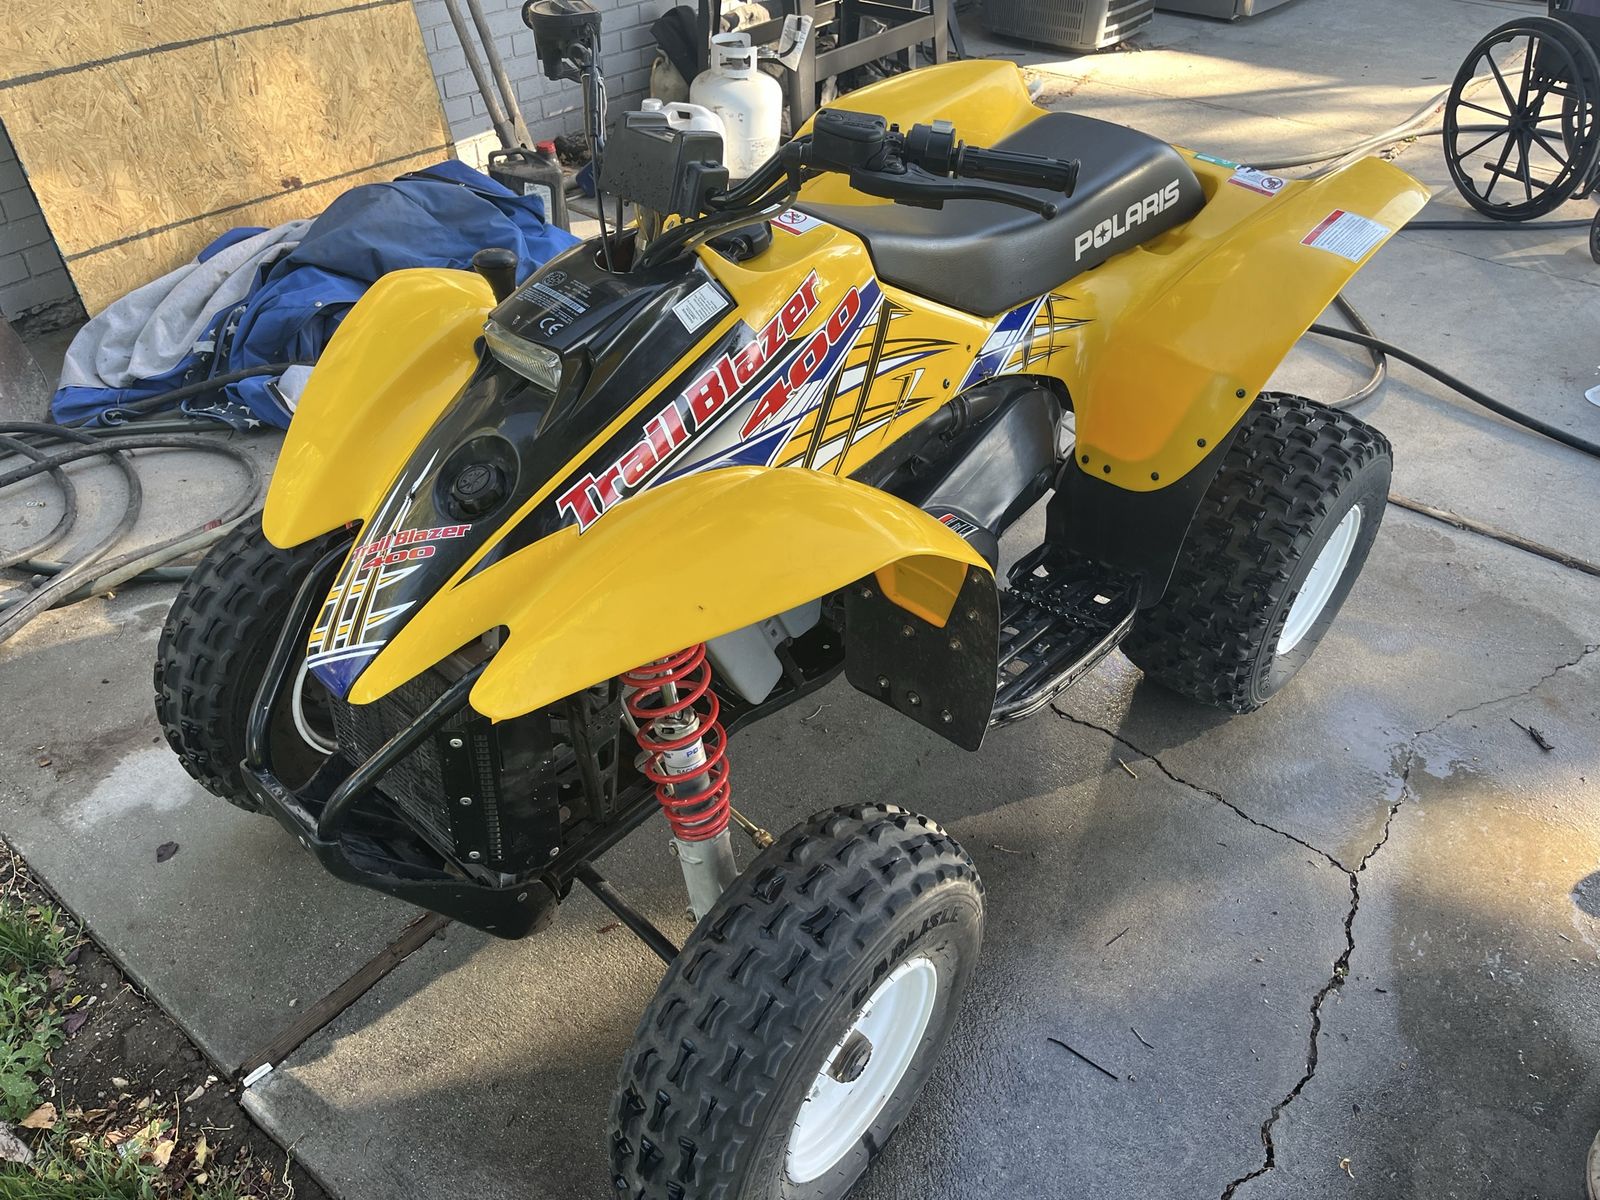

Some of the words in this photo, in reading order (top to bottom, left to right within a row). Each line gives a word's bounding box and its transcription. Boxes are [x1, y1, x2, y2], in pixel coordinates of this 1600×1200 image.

[1073, 179, 1182, 261] POLARIS
[556, 402, 690, 536] Trail
[683, 270, 821, 427] Blazer
[739, 286, 861, 442] 400
[352, 534, 394, 562] Trail
[395, 523, 472, 546] Blazer
[361, 545, 436, 571] 400
[852, 906, 964, 1008] CARLISLE
